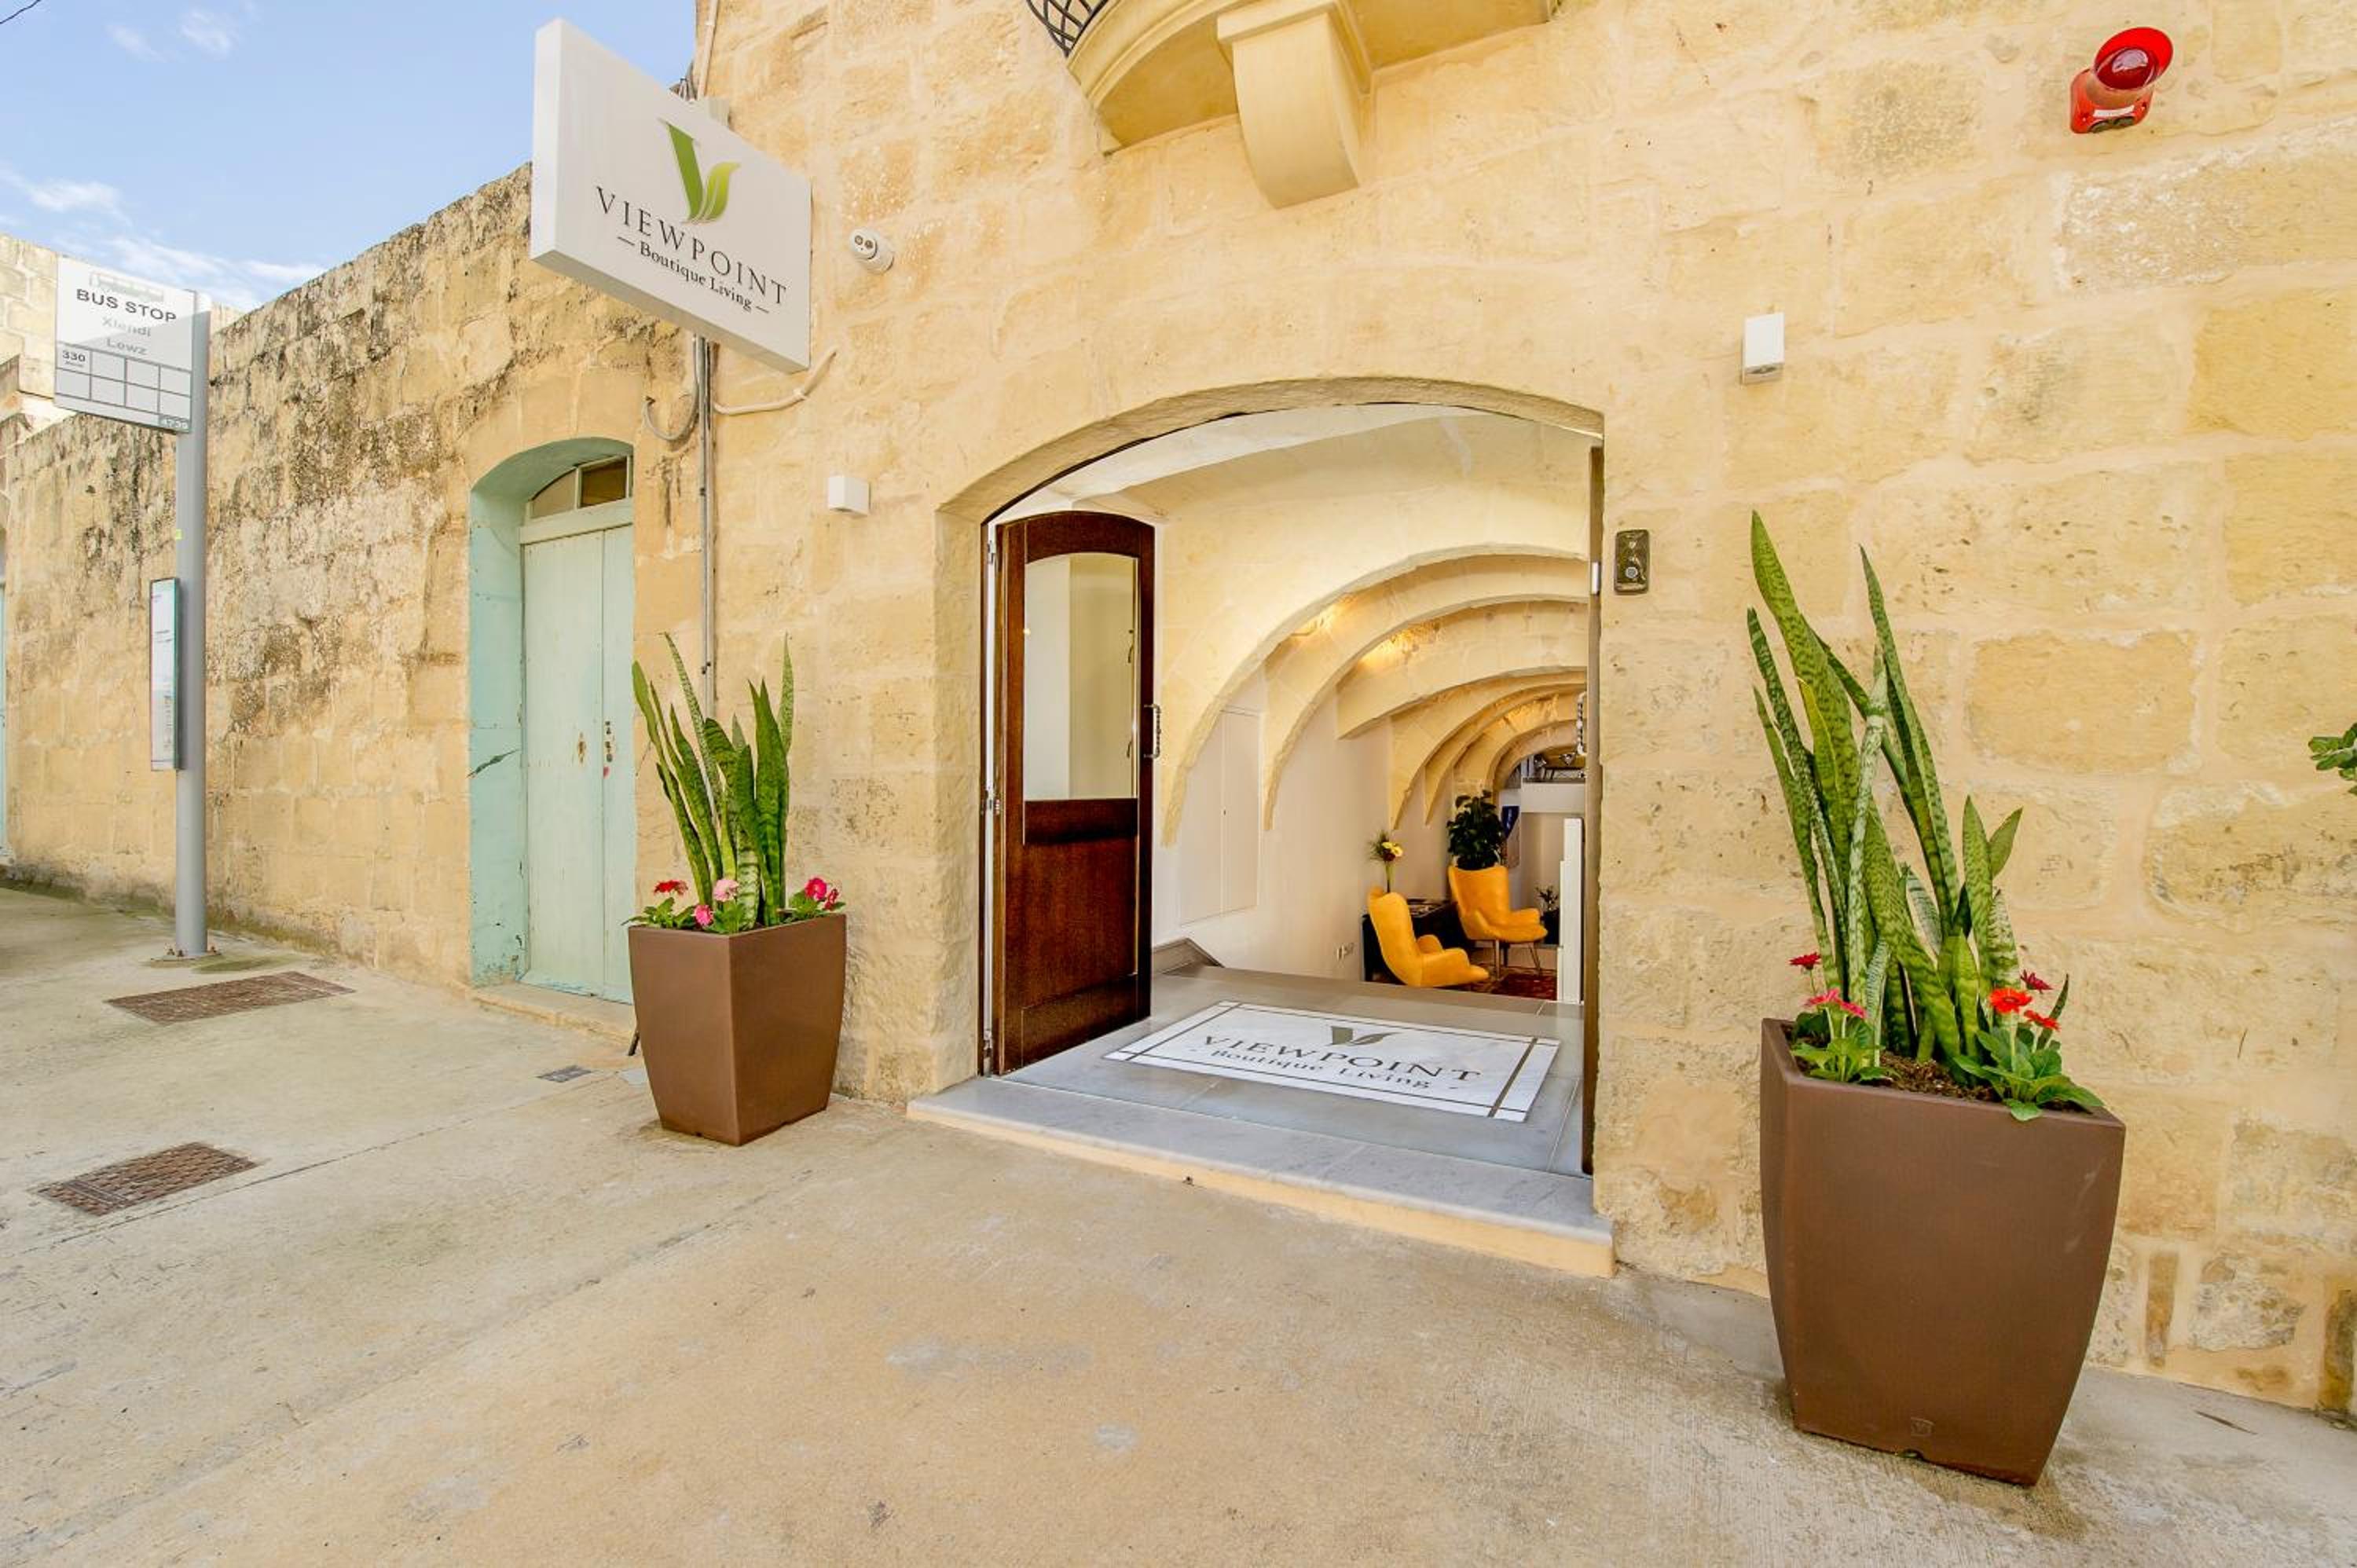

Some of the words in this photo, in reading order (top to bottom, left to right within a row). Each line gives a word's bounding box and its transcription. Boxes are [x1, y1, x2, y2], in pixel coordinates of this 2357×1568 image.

[595, 185, 787, 305] VIEWPOINT
[640, 241, 707, 286] Boutique
[710, 276, 752, 312] Living
[76, 288, 119, 309] BUS
[125, 301, 177, 322] STOP
[62, 350, 86, 362] 330
[1206, 1035, 1481, 1080] VIEWPOINT
[1211, 1050, 1324, 1070] Boutique
[1339, 1068, 1431, 1089] Living
